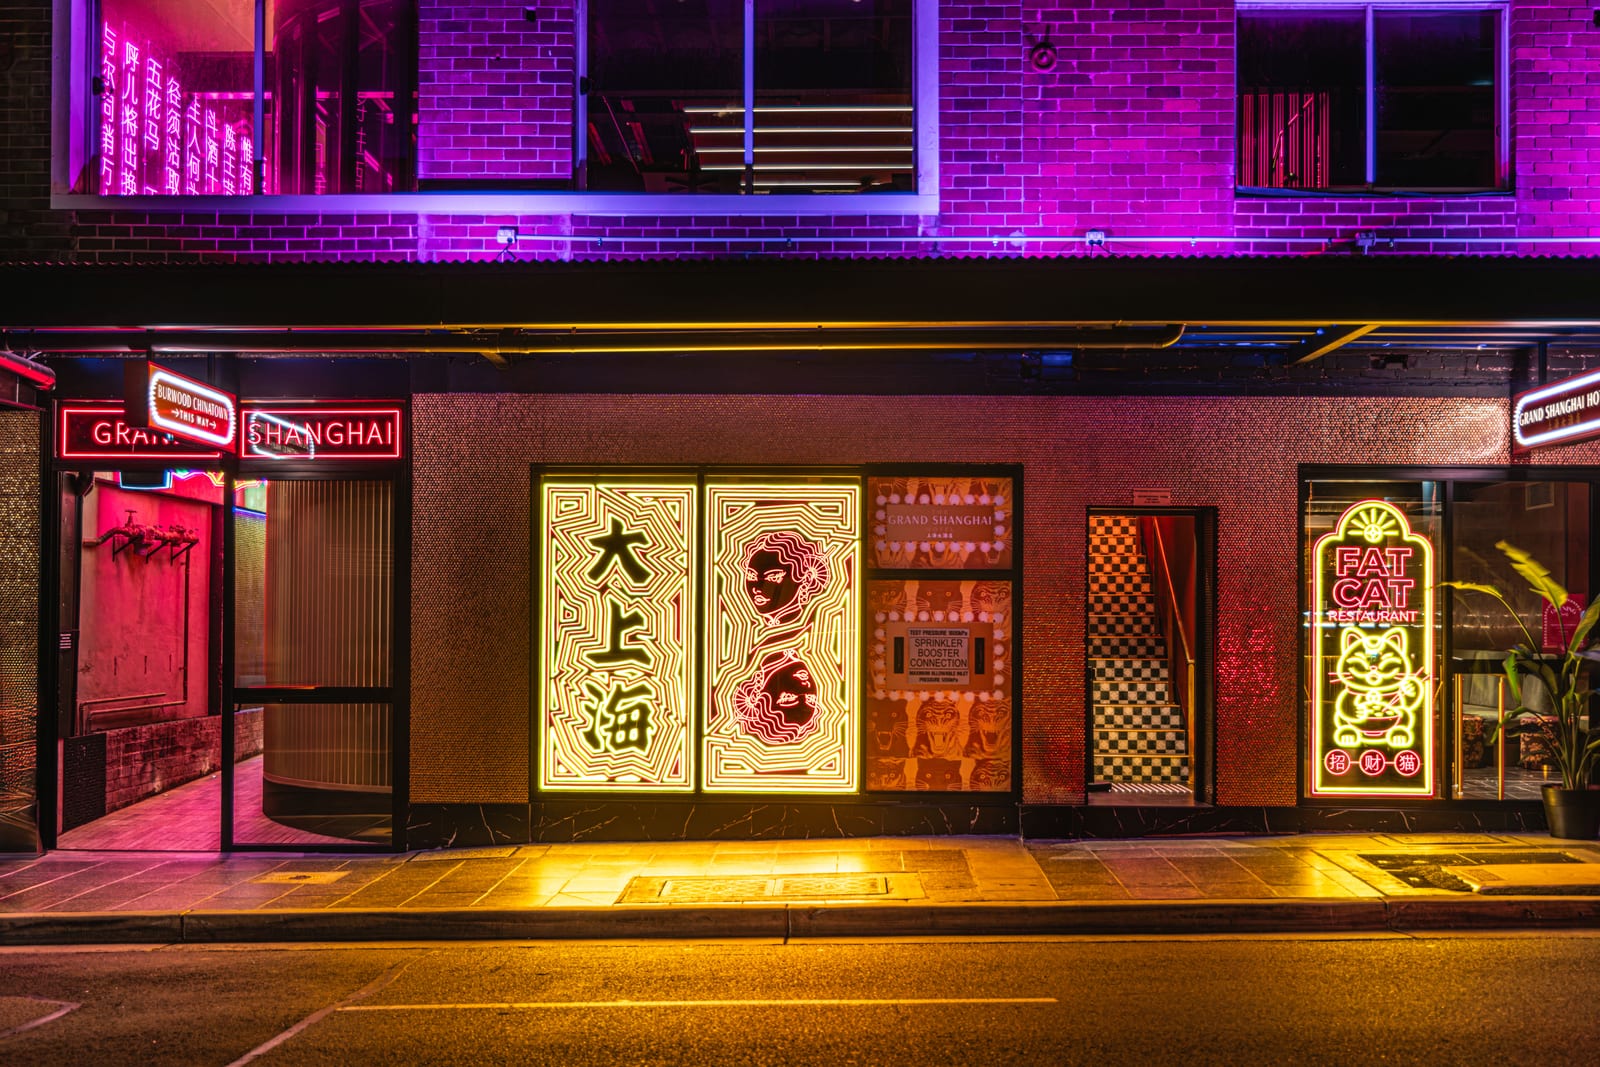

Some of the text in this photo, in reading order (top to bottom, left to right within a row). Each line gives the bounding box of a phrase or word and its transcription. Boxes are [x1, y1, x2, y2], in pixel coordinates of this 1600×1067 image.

[157, 384, 229, 421] BURWOOD CHINATOWN
[1519, 407, 1544, 427] GRAND
[1545, 395, 1585, 419] SHANGHAI
[1587, 390, 1600, 407] HO
[179, 409, 210, 428] THIS WAY
[248, 421, 392, 445] SHANGHAI
[888, 515, 992, 526] GRAND SHANGHAI
[1336, 547, 1412, 577] FAT
[1333, 578, 1414, 608] CAT
[1328, 610, 1418, 622] RESTAURANT
[579, 514, 654, 753] 大上海
[914, 638, 963, 648] SPRINKLER
[917, 648, 960, 658] BOOSTER
[910, 658, 968, 668] CONNECTION
[1329, 753, 1416, 771] 招财猫
